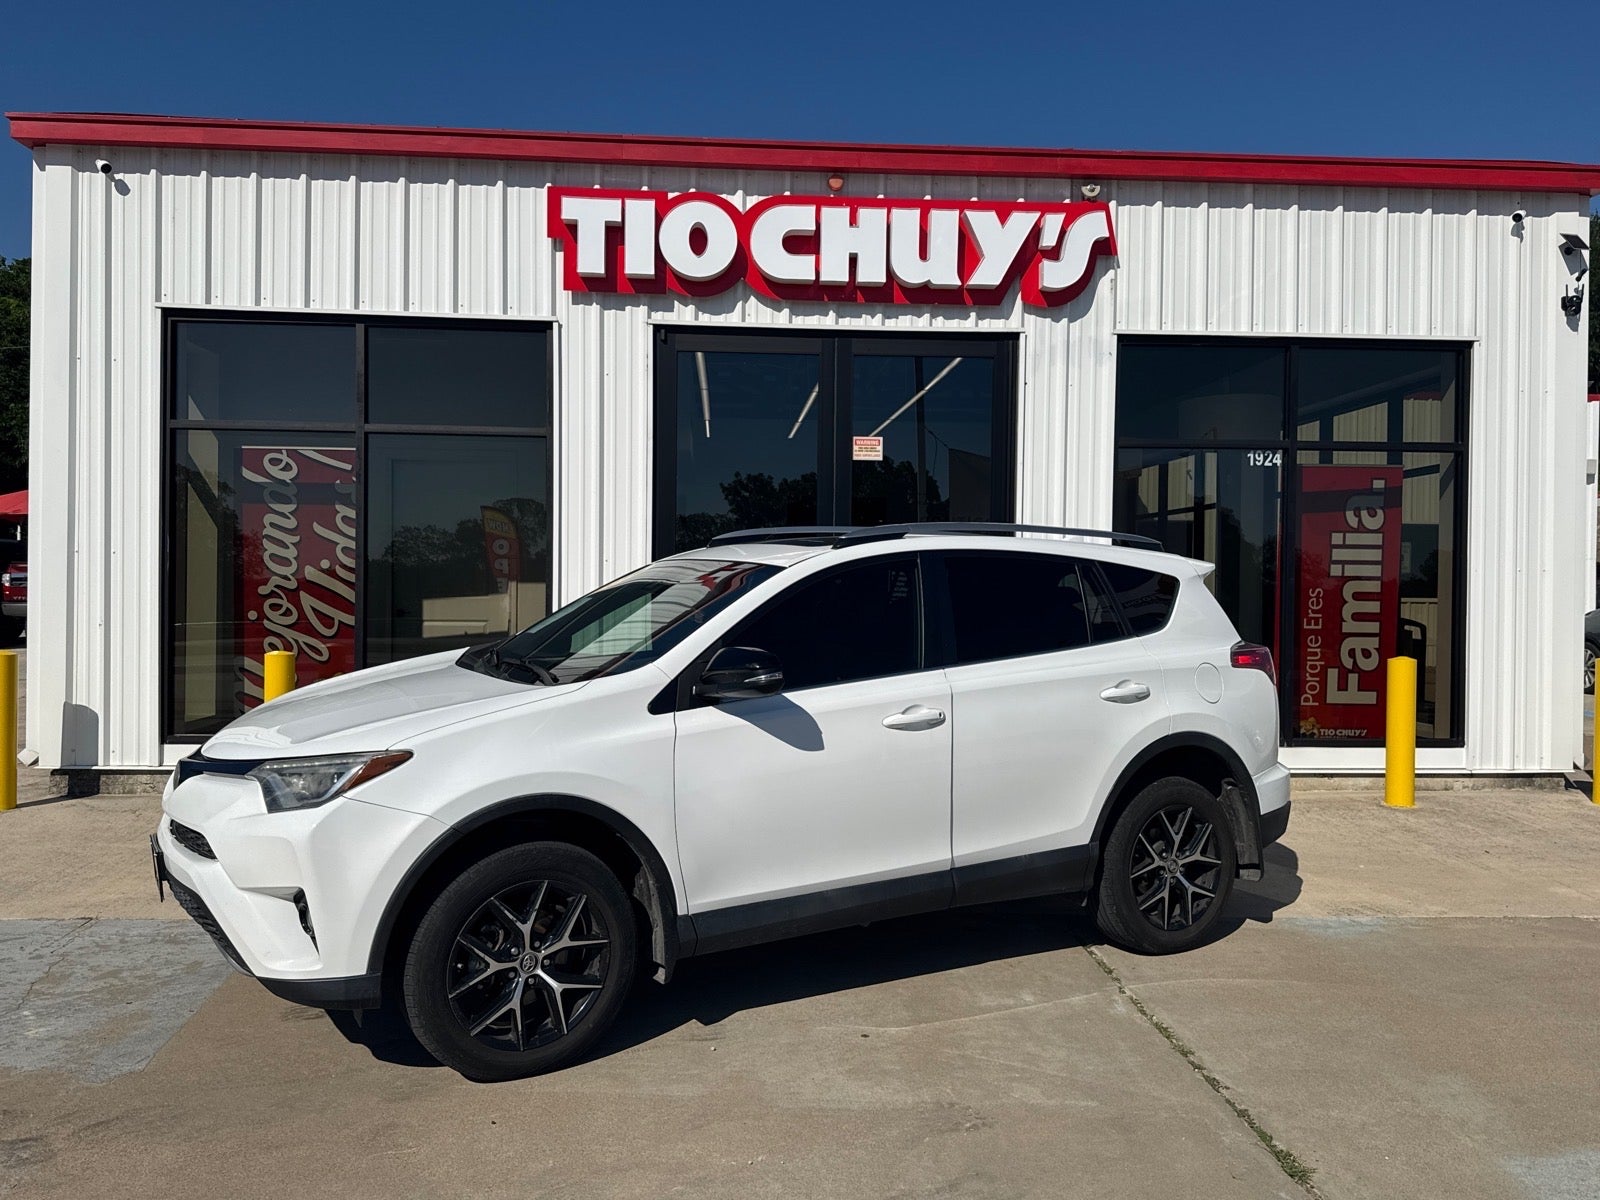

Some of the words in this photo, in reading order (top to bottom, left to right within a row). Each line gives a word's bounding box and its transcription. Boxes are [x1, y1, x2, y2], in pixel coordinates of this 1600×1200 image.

[561, 197, 738, 280] TIO
[750, 203, 1109, 292] CHUY'S
[1247, 450, 1282, 466] 1924
[1304, 587, 1323, 630] Eres
[1326, 479, 1386, 705] Familia.
[1301, 635, 1325, 706] Porque
